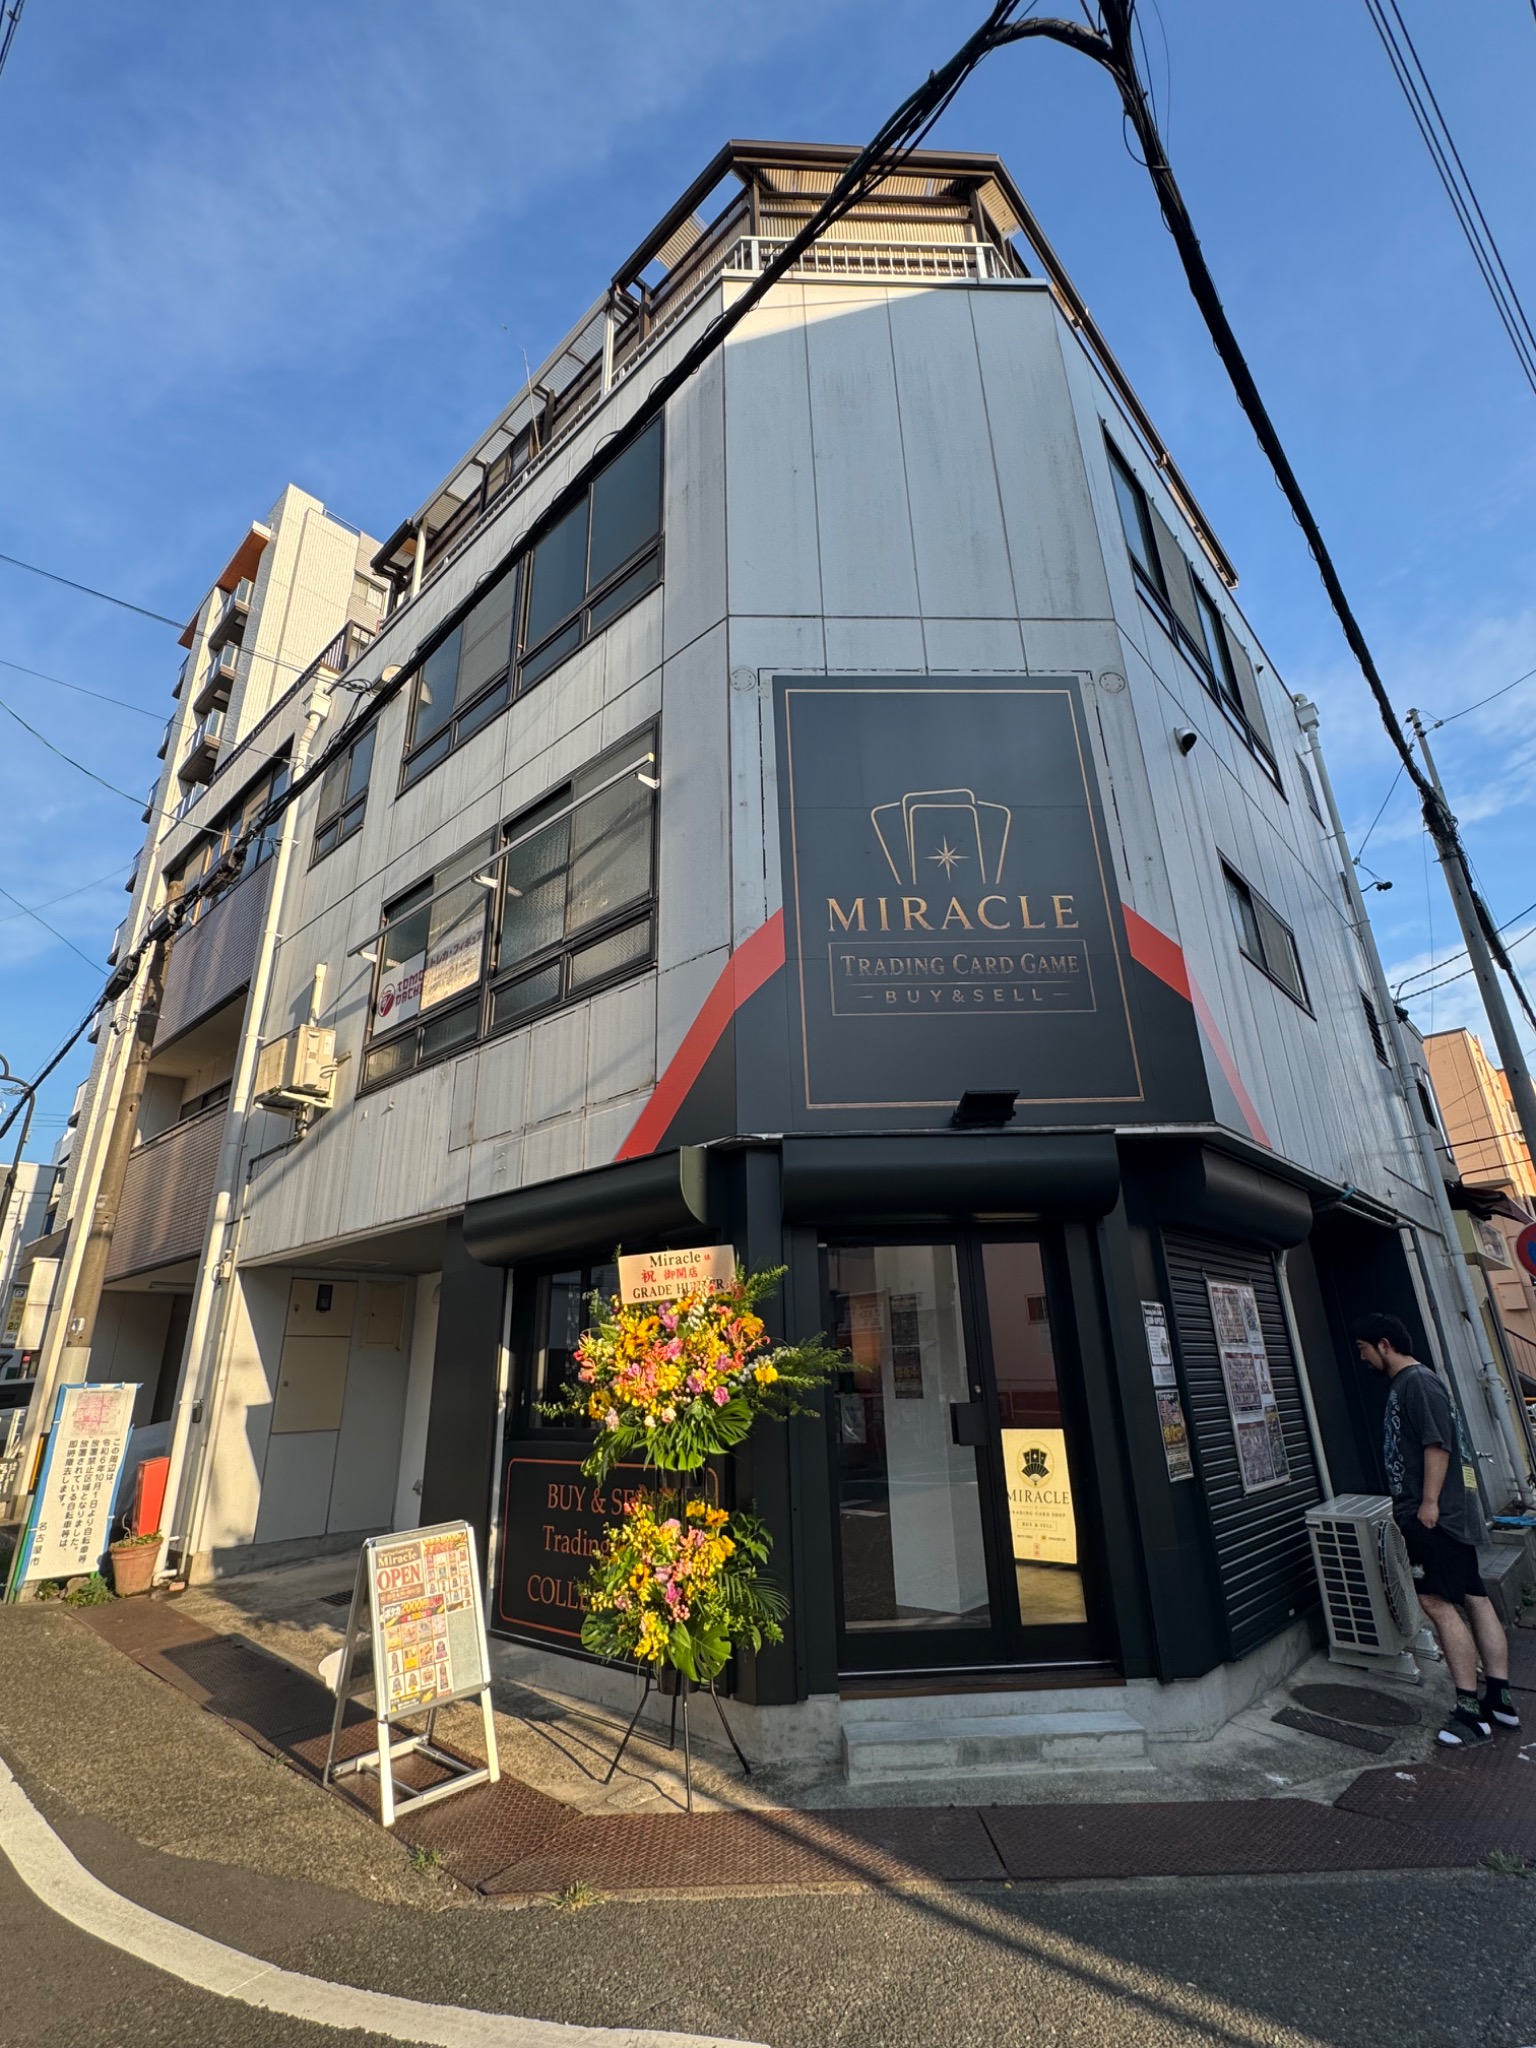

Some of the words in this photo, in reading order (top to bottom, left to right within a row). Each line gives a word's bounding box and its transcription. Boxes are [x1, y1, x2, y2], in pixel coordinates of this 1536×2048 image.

[826, 895, 1080, 932] MIRACLE
[840, 955, 945, 977] TRADING
[952, 953, 1014, 975] CARD
[1020, 952, 1080, 974] GAME
[650, 1251, 701, 1267] Miracle
[641, 1269, 657, 1283] 祝
[664, 1266, 698, 1280] 御開店
[633, 1284, 672, 1299] GRADE
[105, 1438, 121, 1485] この周辺は、
[547, 1484, 587, 1512] BUY
[591, 1487, 605, 1514] &
[1008, 1489, 1070, 1505] MIRACLE
[30, 1521, 48, 1567] 名古屋市
[543, 1525, 611, 1559] Trading
[378, 1551, 418, 1568] Miracle
[377, 1563, 420, 1591] OPEN
